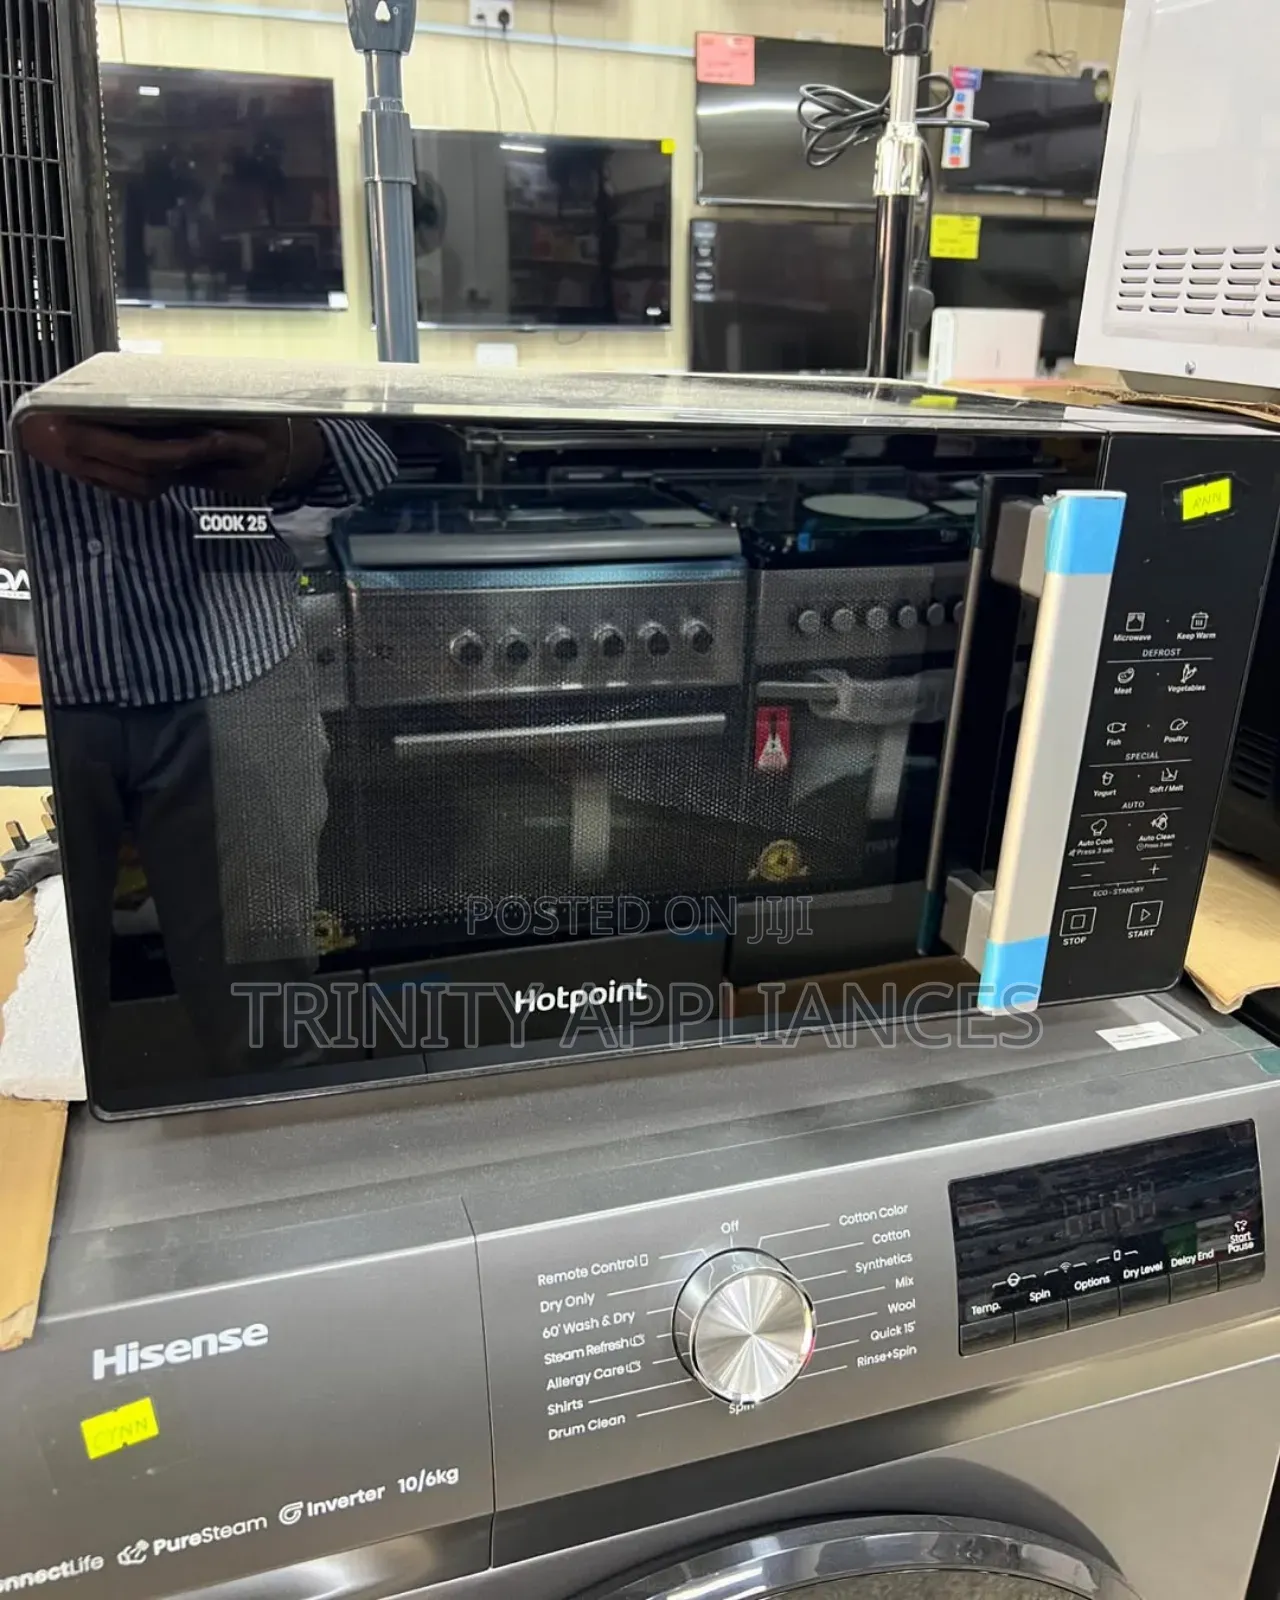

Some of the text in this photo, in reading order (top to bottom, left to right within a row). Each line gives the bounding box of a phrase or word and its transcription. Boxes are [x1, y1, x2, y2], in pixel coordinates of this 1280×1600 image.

[200, 514, 268, 532] COOK 25
[1113, 633, 1152, 642] Microwave
[1177, 631, 1216, 641] Keep Warm
[1142, 648, 1181, 658] DEFROST
[1114, 686, 1132, 695] Meat
[1167, 683, 1206, 693] Vegetables
[1106, 738, 1122, 747] Fish
[1163, 735, 1189, 744] Poultry
[1125, 751, 1160, 761] SPECIAL
[1093, 788, 1117, 798] Yogurt
[1149, 785, 1164, 794] Soft
[1169, 784, 1184, 792] Melt
[1121, 800, 1145, 810] AUTO
[1077, 838, 1114, 847] Auto Cook
[1138, 833, 1176, 842] Auto Clean
[1093, 888, 1108, 897] ECO
[1113, 886, 1145, 895] STANDBY
[1063, 936, 1087, 946] STOP
[1128, 928, 1156, 939] START
[515, 978, 648, 1014] Hotpoint
[838, 1203, 909, 1228] Cotton Color
[720, 1219, 739, 1235] Off
[871, 1227, 911, 1246] Cotton
[1229, 1231, 1252, 1244] Start
[1227, 1240, 1254, 1255] Pause
[855, 1251, 913, 1274] Synthetics
[1170, 1248, 1215, 1269] Delay End
[537, 1255, 639, 1287] Remote Control
[1123, 1261, 1163, 1280] Dry Level
[895, 1275, 915, 1290] Mix
[1074, 1274, 1111, 1292] Options
[540, 1291, 596, 1314] Dry Only
[1029, 1287, 1051, 1302] Spin
[887, 1298, 916, 1315] Wool
[971, 1302, 1002, 1317] Temp.
[563, 1317, 599, 1335] Wash
[601, 1315, 612, 1327] &
[613, 1310, 636, 1326] Dry
[870, 1324, 902, 1342] Quick
[93, 1323, 268, 1380] Hisense
[543, 1337, 630, 1366] Steam Refresh
[857, 1344, 917, 1368] Rinse+Spin
[546, 1364, 625, 1391] Allergy Care
[547, 1398, 584, 1416] Shirts
[548, 1413, 626, 1441] Drum Clean
[397, 1466, 460, 1494] 10/6kg
[307, 1485, 387, 1518] Inverter
[152, 1514, 268, 1556] PureSteam
